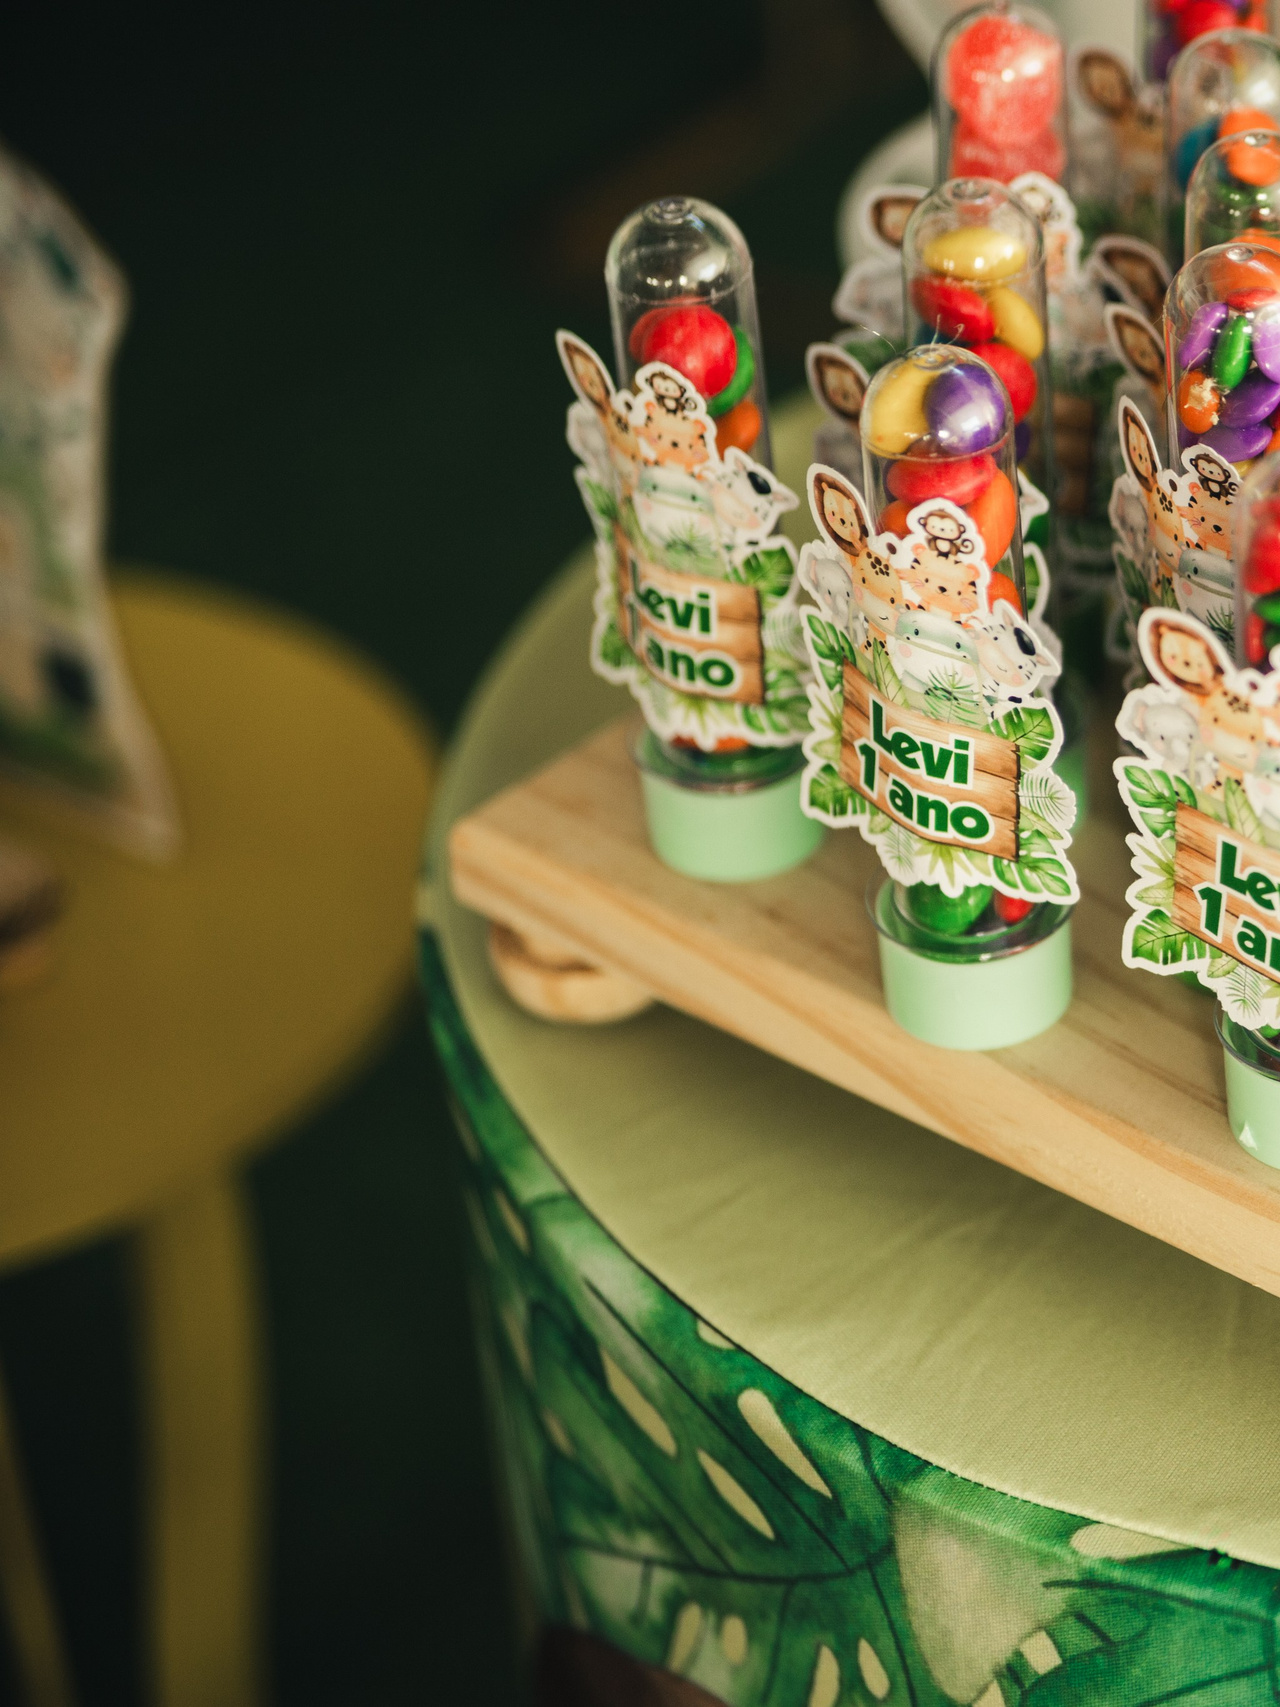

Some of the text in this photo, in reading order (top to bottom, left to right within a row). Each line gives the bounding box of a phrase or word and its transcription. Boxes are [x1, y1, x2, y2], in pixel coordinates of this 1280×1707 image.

[631, 560, 710, 633] Levi
[647, 638, 734, 687] ano
[872, 699, 970, 785] Levi
[859, 743, 990, 839] 1 ano
[1198, 886, 1223, 937] 1
